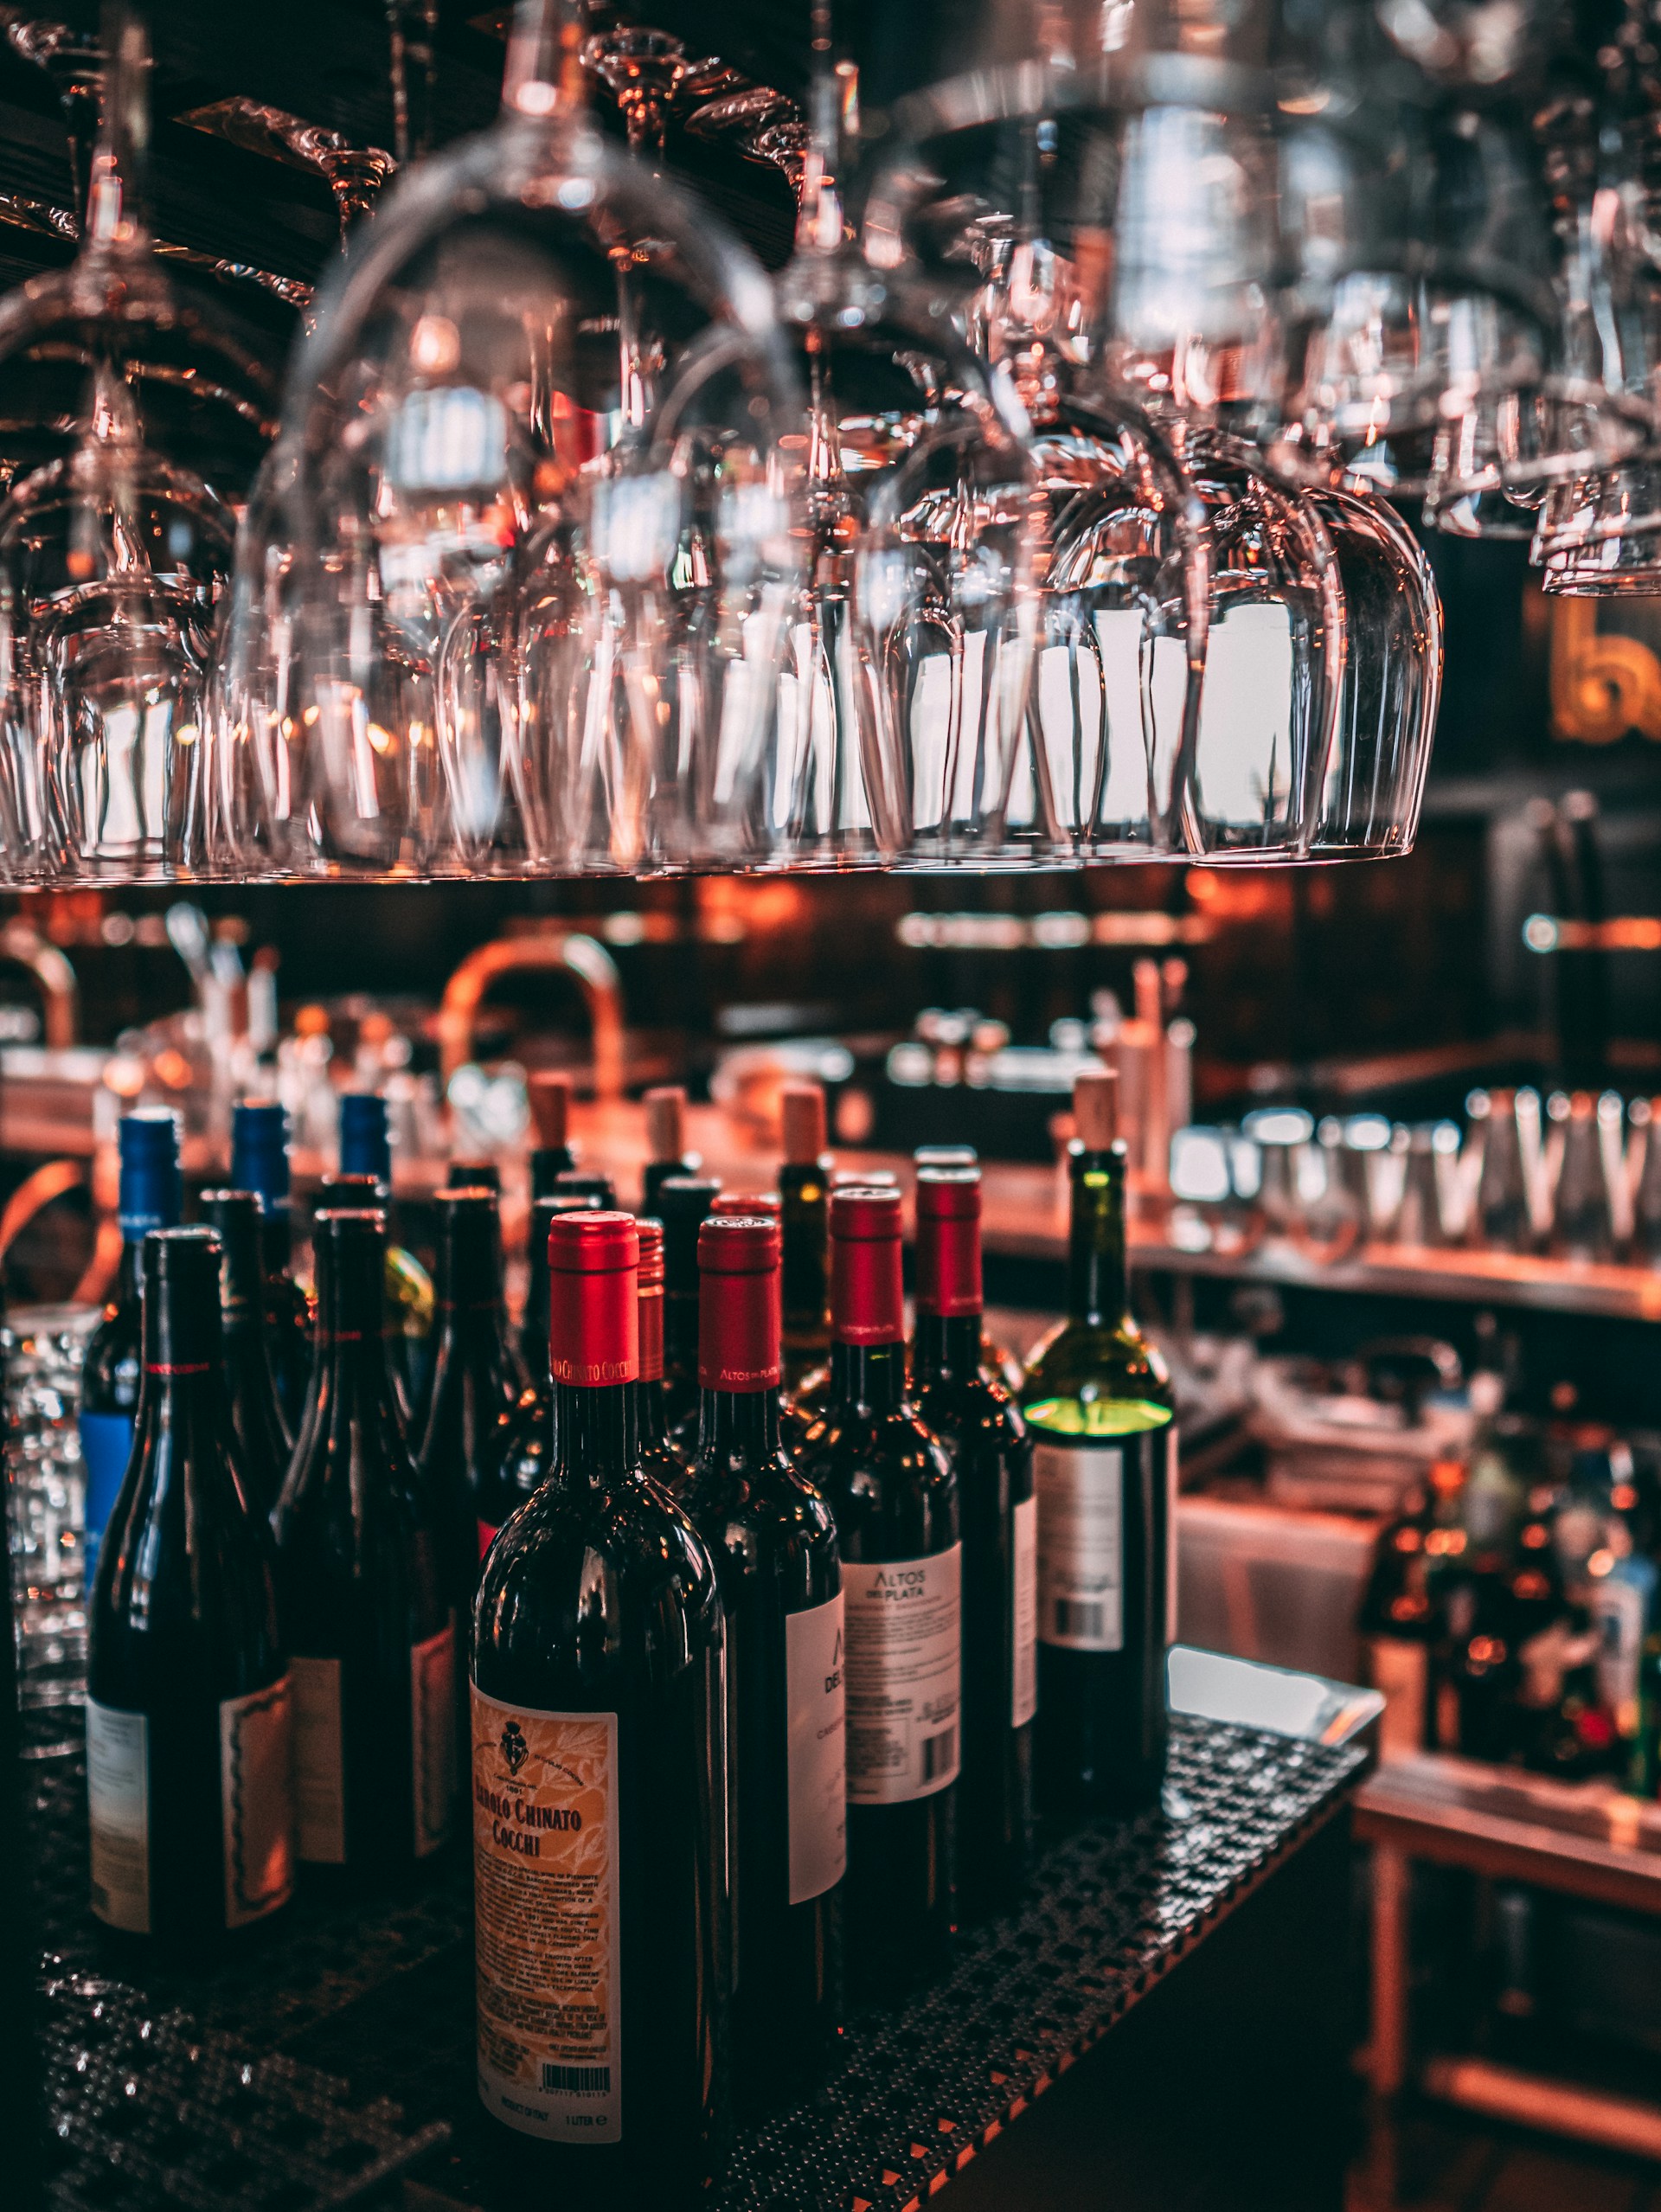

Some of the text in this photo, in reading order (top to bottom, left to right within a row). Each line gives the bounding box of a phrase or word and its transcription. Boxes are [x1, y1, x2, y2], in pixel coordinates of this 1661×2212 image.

[720, 1369, 750, 1381] ALTOS
[874, 1570, 926, 1587] ALTOS
[885, 1587, 925, 1600] PLATA
[516, 1798, 582, 1831] CHINATO
[492, 1819, 540, 1857] COCCHI
